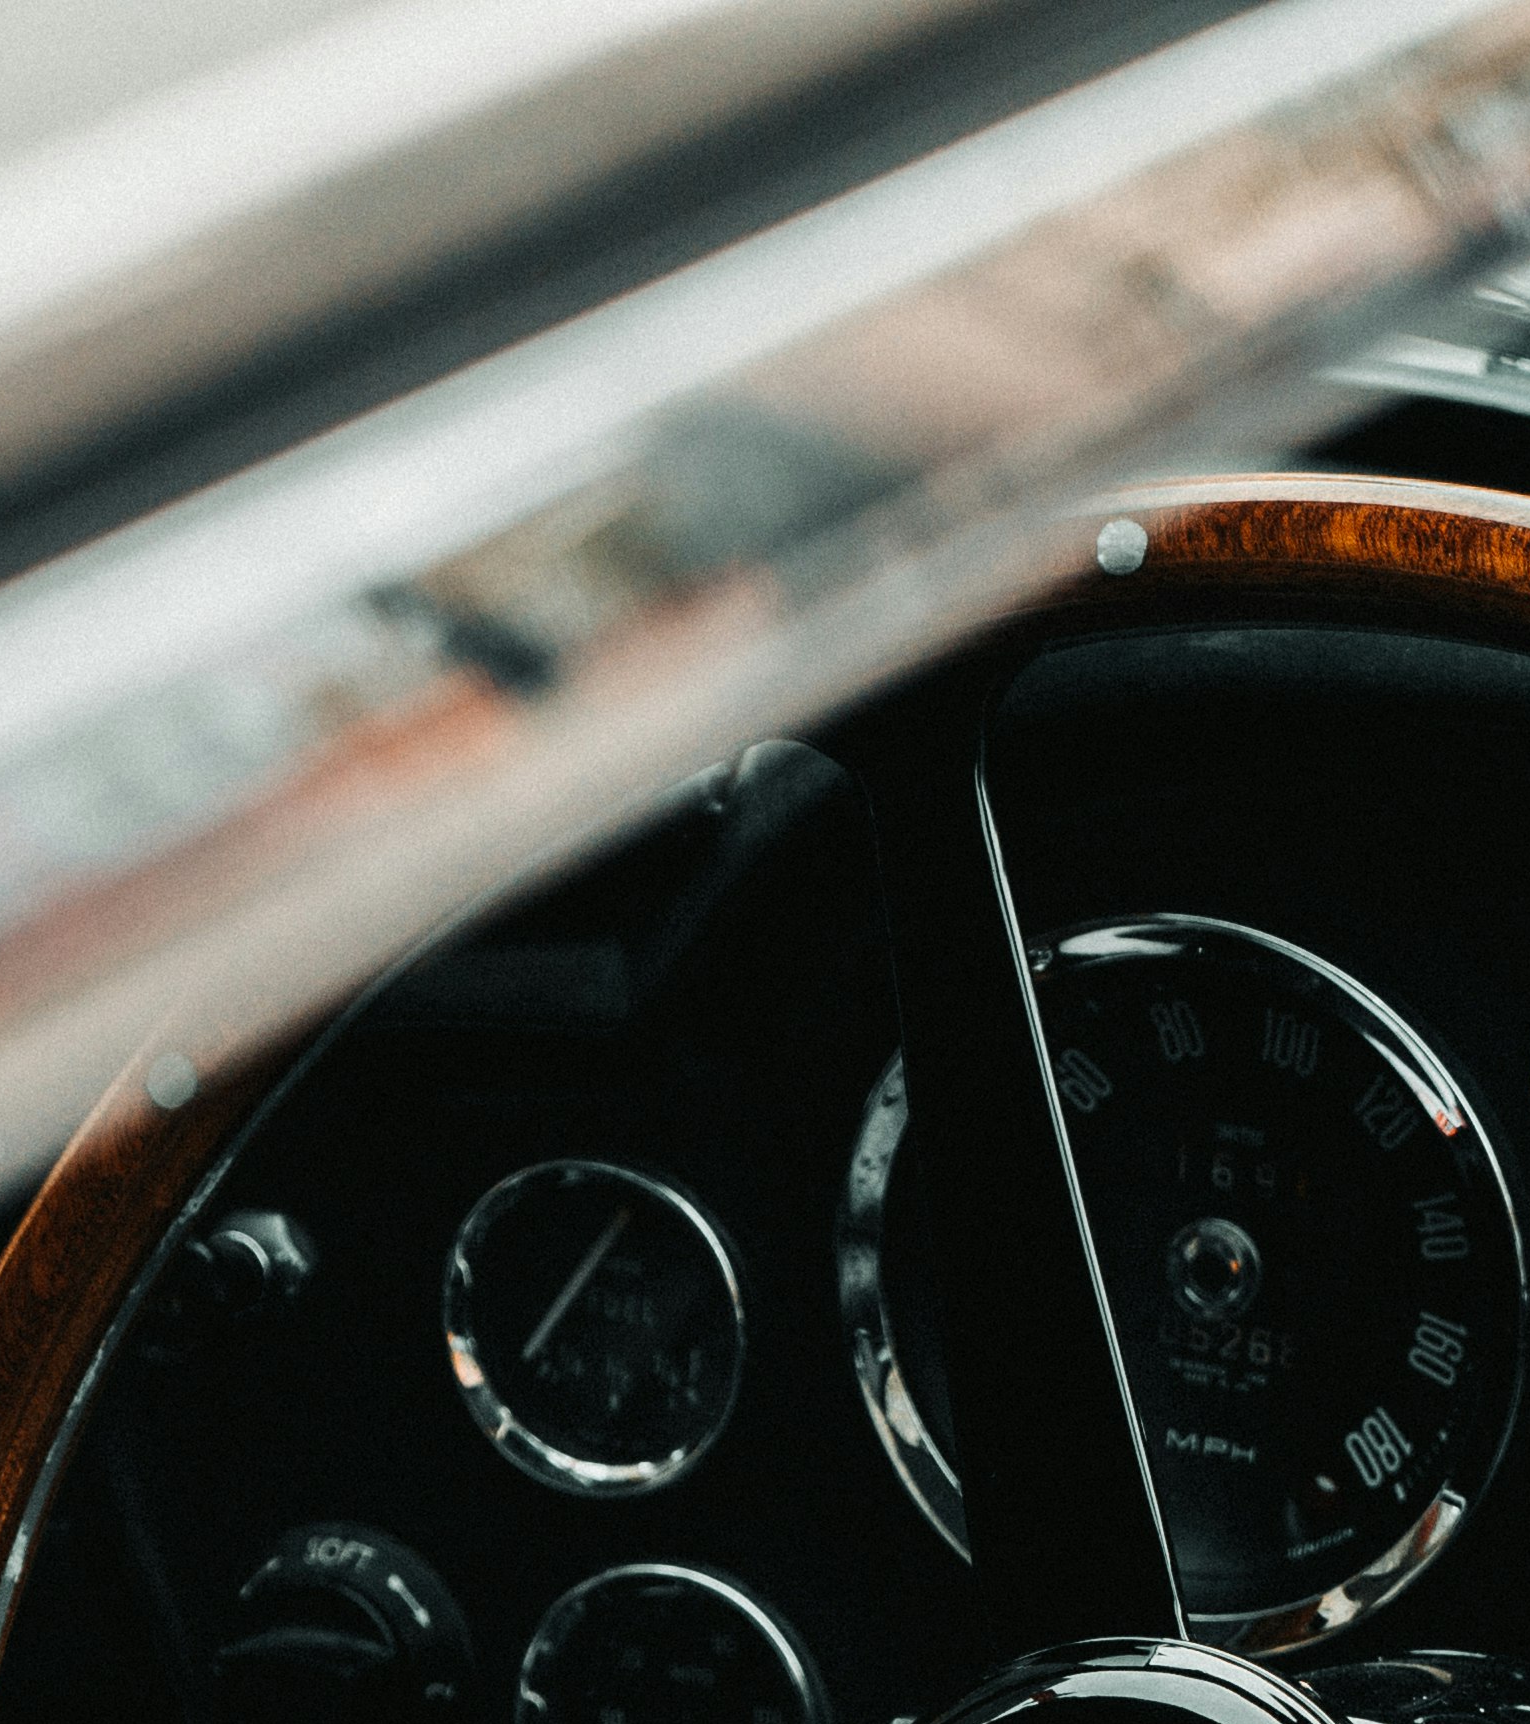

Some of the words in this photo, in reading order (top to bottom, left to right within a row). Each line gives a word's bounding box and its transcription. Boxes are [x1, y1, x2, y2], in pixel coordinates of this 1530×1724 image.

[1149, 998, 1206, 1057] 80
[1260, 1006, 1320, 1078] 100
[1353, 1072, 1422, 1151] 120
[1410, 1191, 1470, 1261] 140
[1406, 1310, 1469, 1387] 160
[1164, 1426, 1256, 1465] MPH
[1343, 1405, 1413, 1490] 180
[303, 1536, 376, 1574] SOFT
